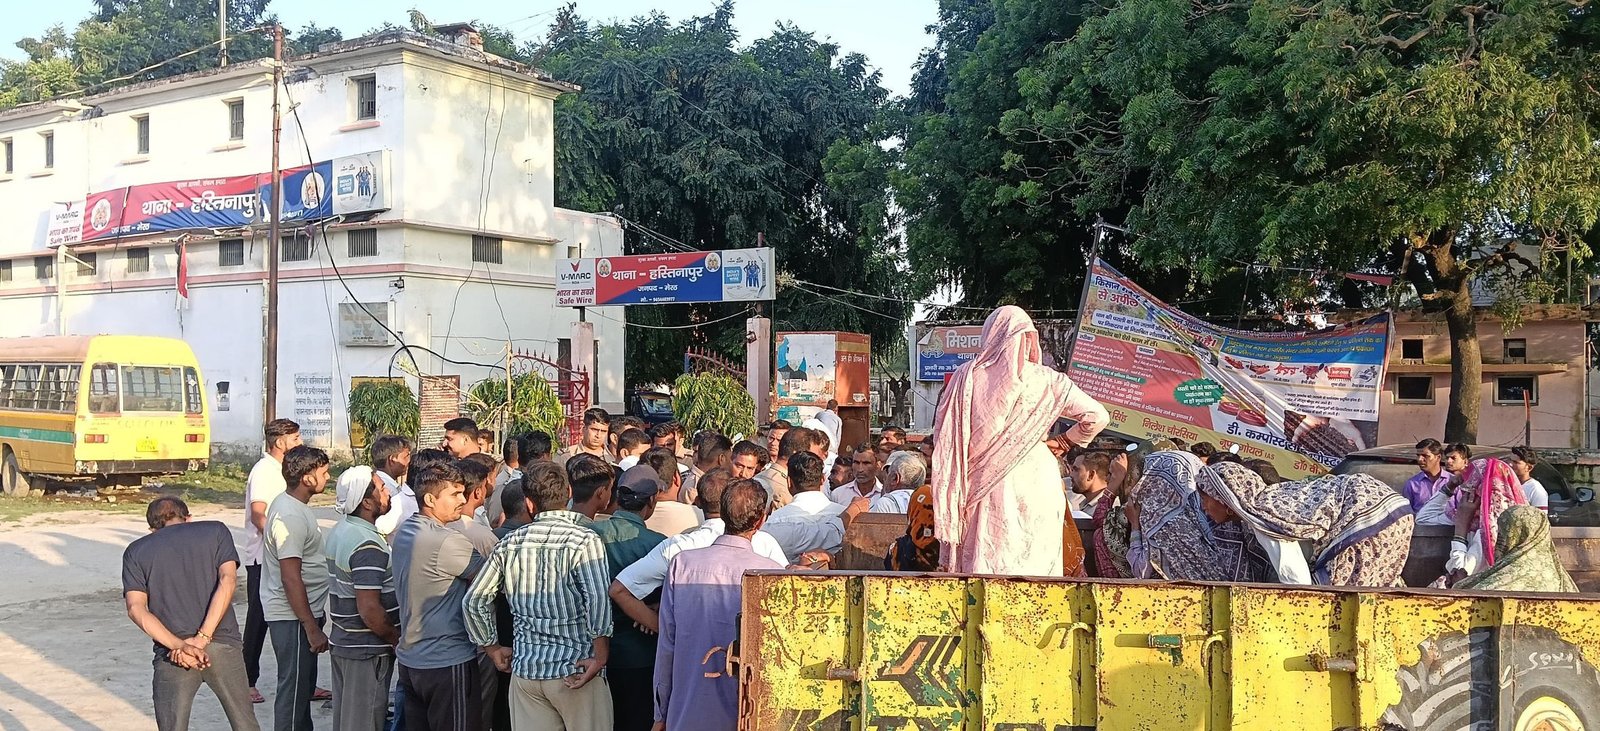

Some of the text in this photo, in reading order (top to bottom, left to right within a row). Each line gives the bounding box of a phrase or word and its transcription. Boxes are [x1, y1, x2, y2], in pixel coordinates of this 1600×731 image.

[142, 199, 172, 215] थाना
[56, 211, 78, 220] V-MARC
[137, 222, 150, 231] मेरठ
[50, 236, 63, 245] Safe
[561, 272, 591, 280] V-MARC
[612, 270, 636, 280] थाना
[650, 266, 704, 282] हस्तिनापुर
[1095, 276, 1120, 290] किसान
[1098, 289, 1108, 300] से
[1110, 294, 1138, 307] अपील
[945, 330, 982, 348] मिशन
[1112, 410, 1128, 423] सिंह
[1143, 418, 1165, 432] निलेश
[1227, 422, 1241, 435] डी.
[1239, 443, 1264, 457] गोयल
[1264, 452, 1275, 460] IAS
